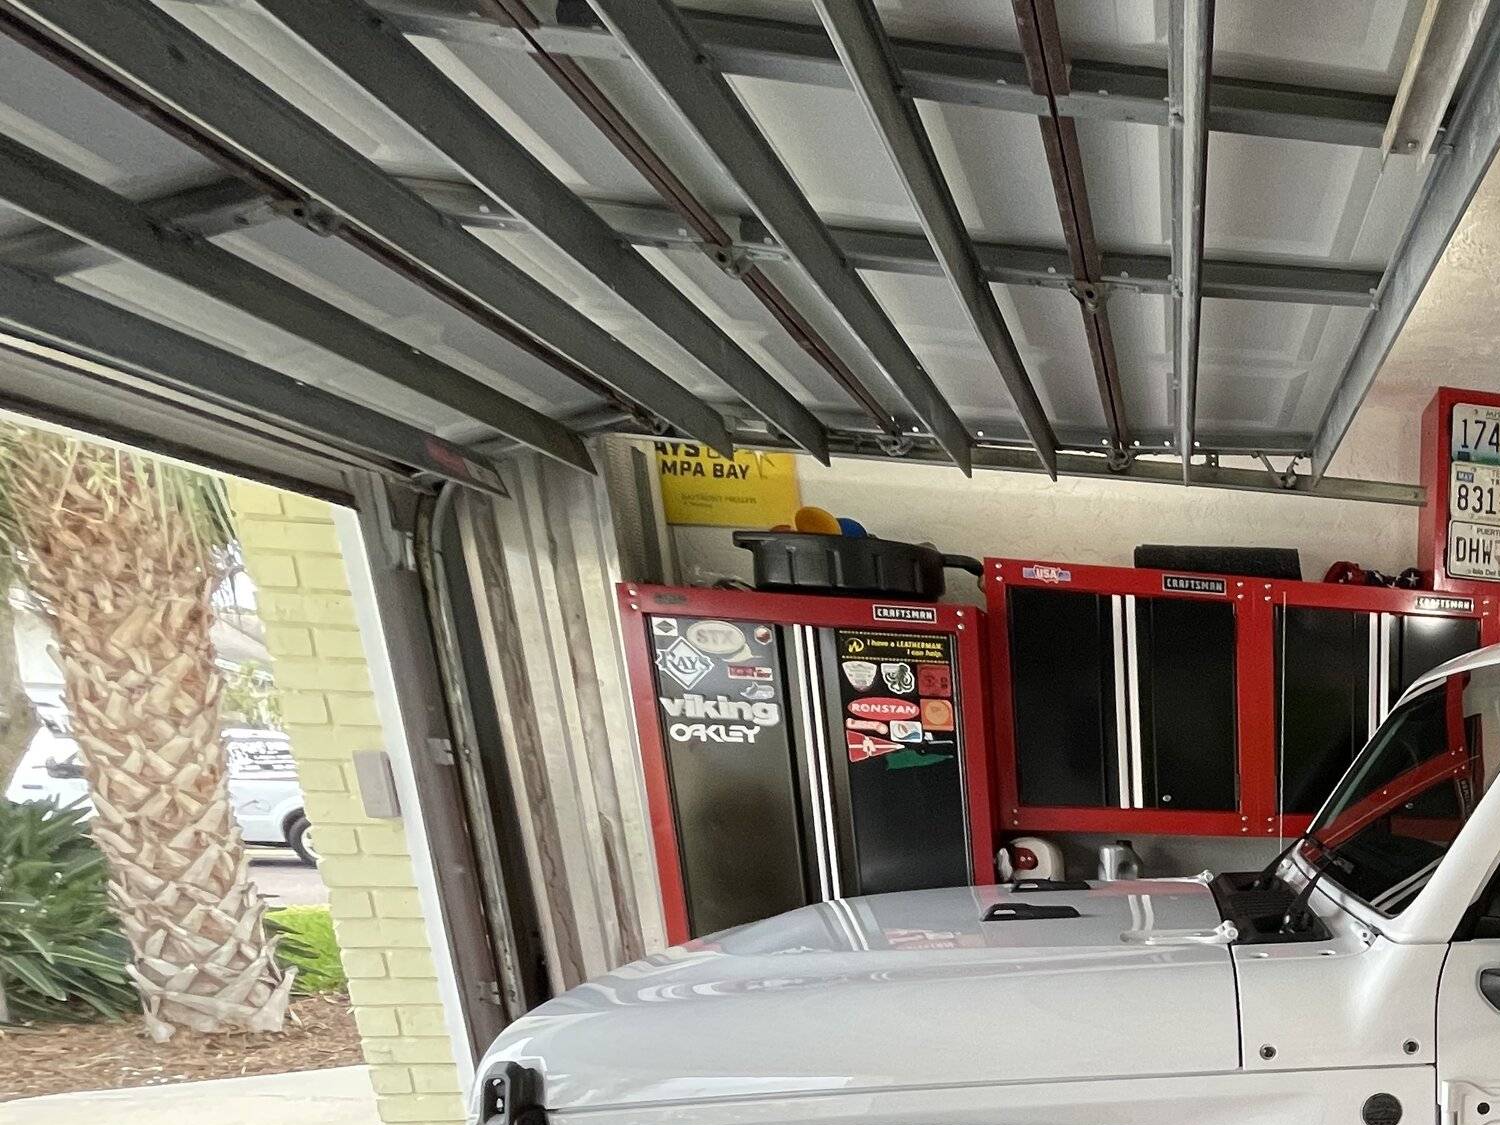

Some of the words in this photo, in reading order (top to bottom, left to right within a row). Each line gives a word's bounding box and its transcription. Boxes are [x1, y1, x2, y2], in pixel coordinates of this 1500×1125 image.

[1461, 419, 1500, 453] 174
[654, 441, 700, 457] AYS
[662, 459, 706, 477] MPA
[713, 463, 750, 480] BAY
[1457, 484, 1497, 515] 831
[1456, 536, 1492, 565] DHW
[1036, 567, 1058, 579] USA
[1166, 578, 1223, 591] CRAFTSMAN
[877, 608, 933, 620] CRAFTSMAN
[696, 629, 734, 644] STX
[659, 693, 780, 727] viking
[851, 703, 918, 715] RONSTAN
[669, 723, 761, 743] OAKLEY
